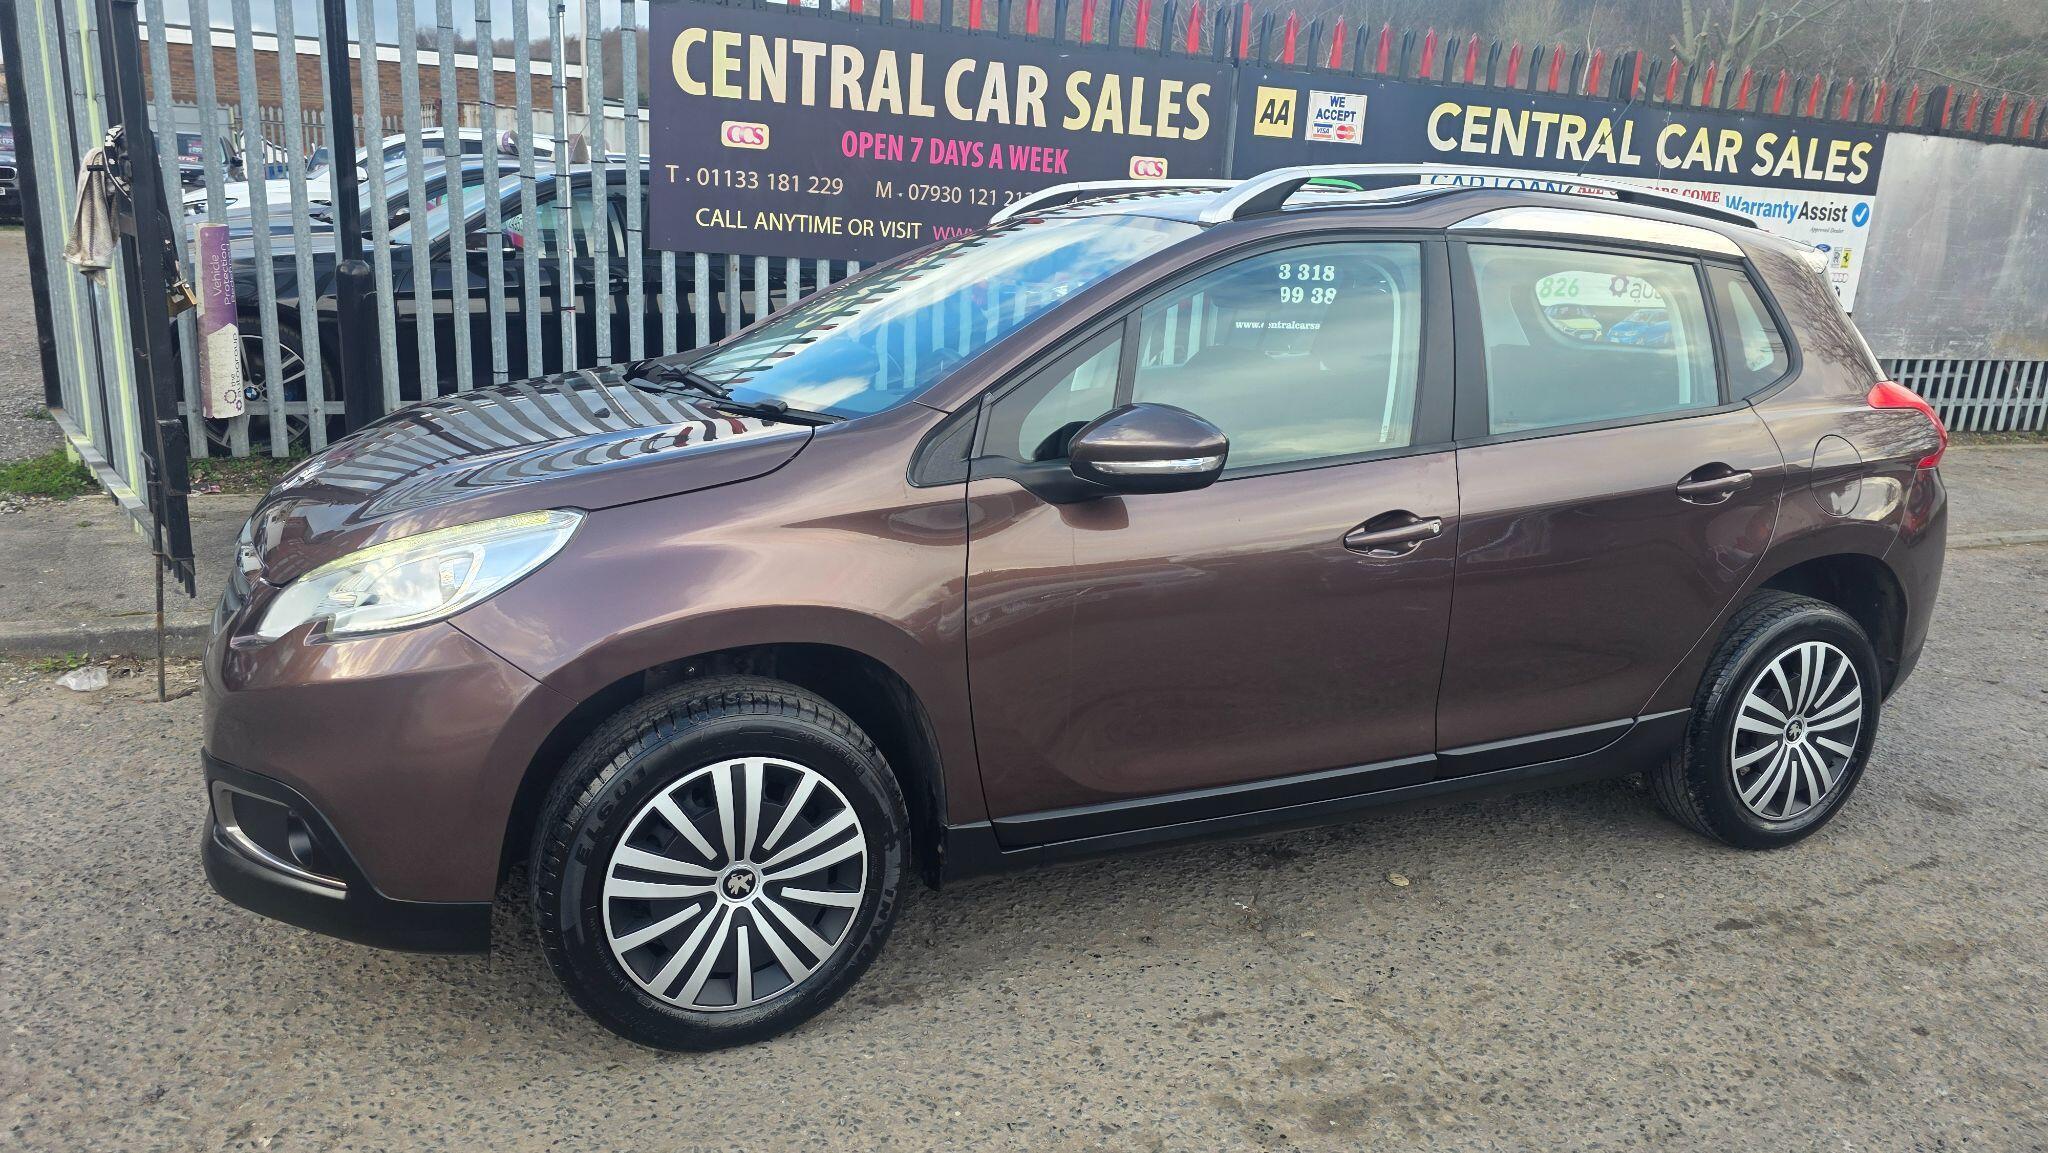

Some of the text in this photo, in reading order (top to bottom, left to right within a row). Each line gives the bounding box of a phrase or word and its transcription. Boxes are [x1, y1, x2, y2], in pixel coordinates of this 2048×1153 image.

[671, 27, 1211, 141] CENTRAL CAR SALES
[1259, 98, 1290, 126] AA
[1315, 108, 1356, 122] ACCEPT
[1330, 95, 1346, 108] WE
[841, 130, 1070, 175] OPEN 7 DAYS A WEEK
[1427, 102, 1873, 184] CENTRAL CAR SALES
[696, 167, 759, 189] 01133
[767, 173, 799, 192] 181
[806, 175, 844, 195] 229
[908, 183, 962, 204] 07930
[969, 188, 996, 206] 121
[695, 207, 747, 229] CALL
[754, 211, 843, 235] ANYTIME
[847, 218, 874, 238] OR
[879, 220, 922, 240] VISIT
[1725, 195, 1848, 224] WarrantyAssist
[210, 254, 222, 297] Vehicle
[220, 243, 231, 305] Protection
[1279, 263, 1335, 281] 3 318
[1540, 277, 1579, 299] 826
